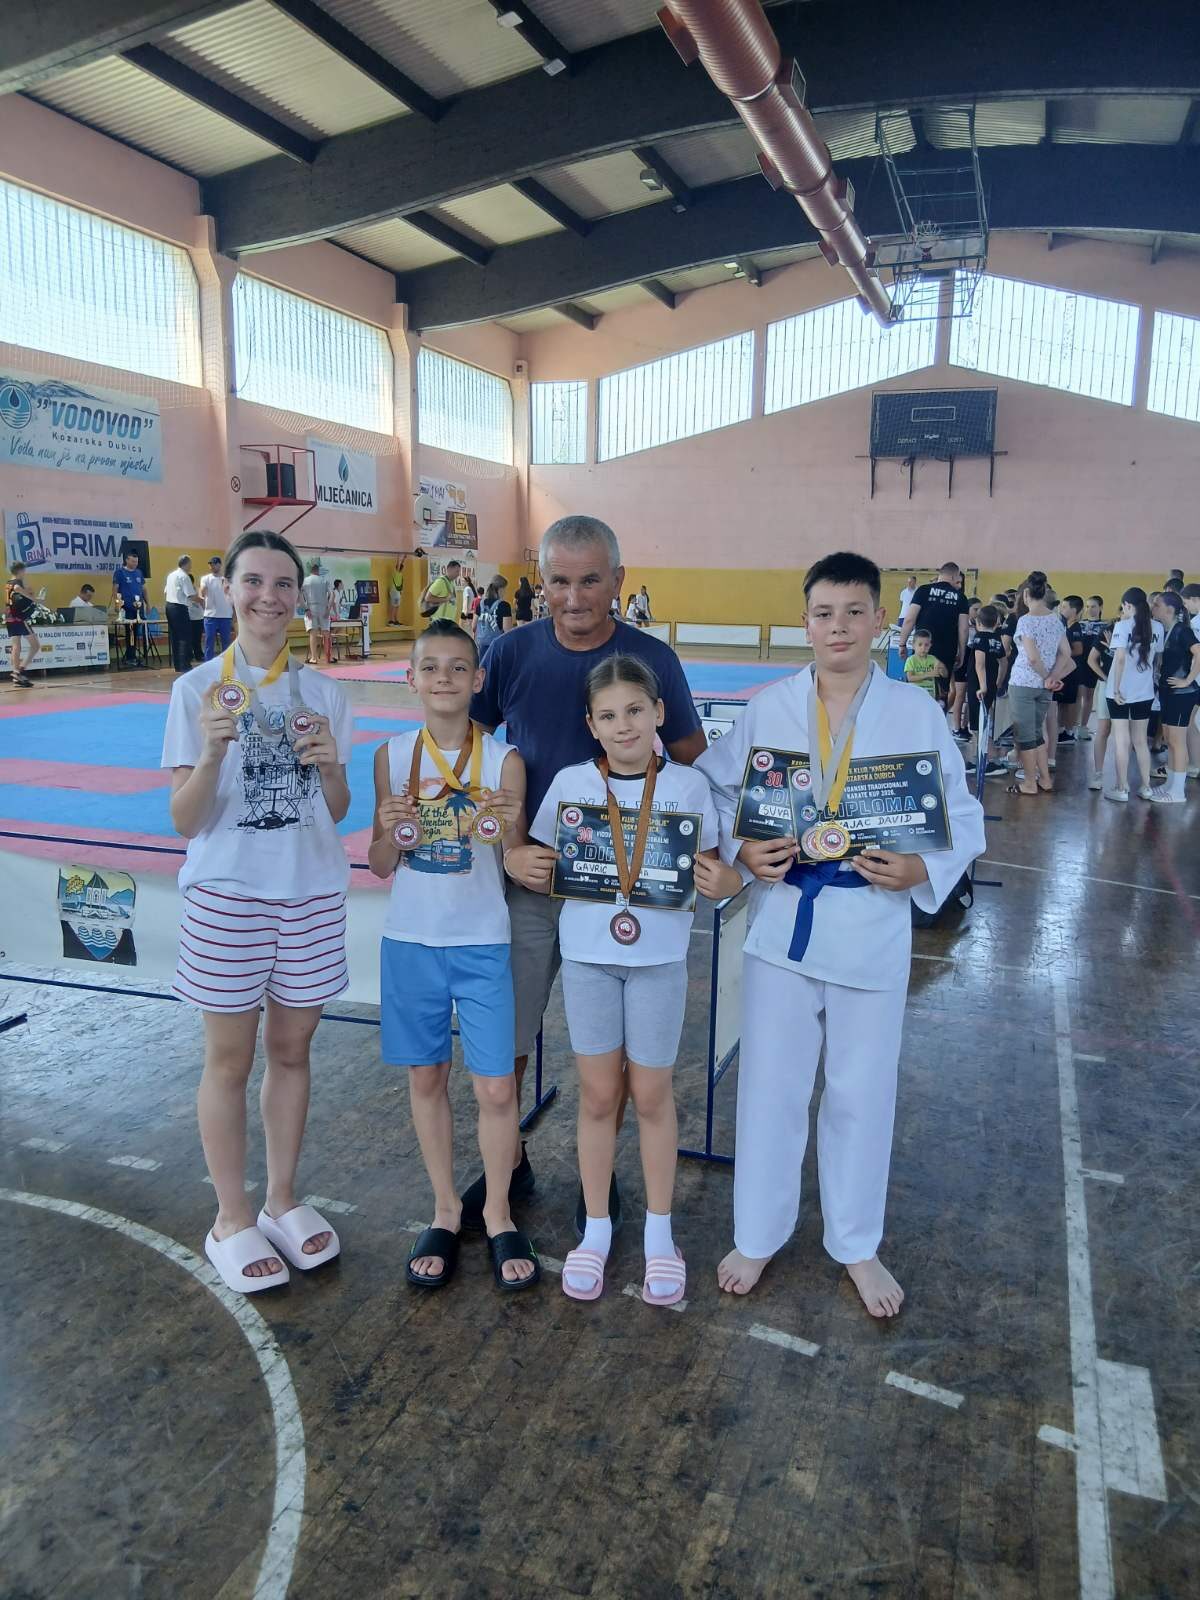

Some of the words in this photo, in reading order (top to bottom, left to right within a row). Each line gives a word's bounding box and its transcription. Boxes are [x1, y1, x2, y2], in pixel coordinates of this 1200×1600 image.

[10, 435, 34, 457] Voda
[315, 485, 373, 508] MLJEČANICA
[763, 805, 790, 816] SUVA
[419, 817, 453, 827] dventure
[879, 814, 912, 826] DAVID
[585, 844, 673, 868] DIPMA
